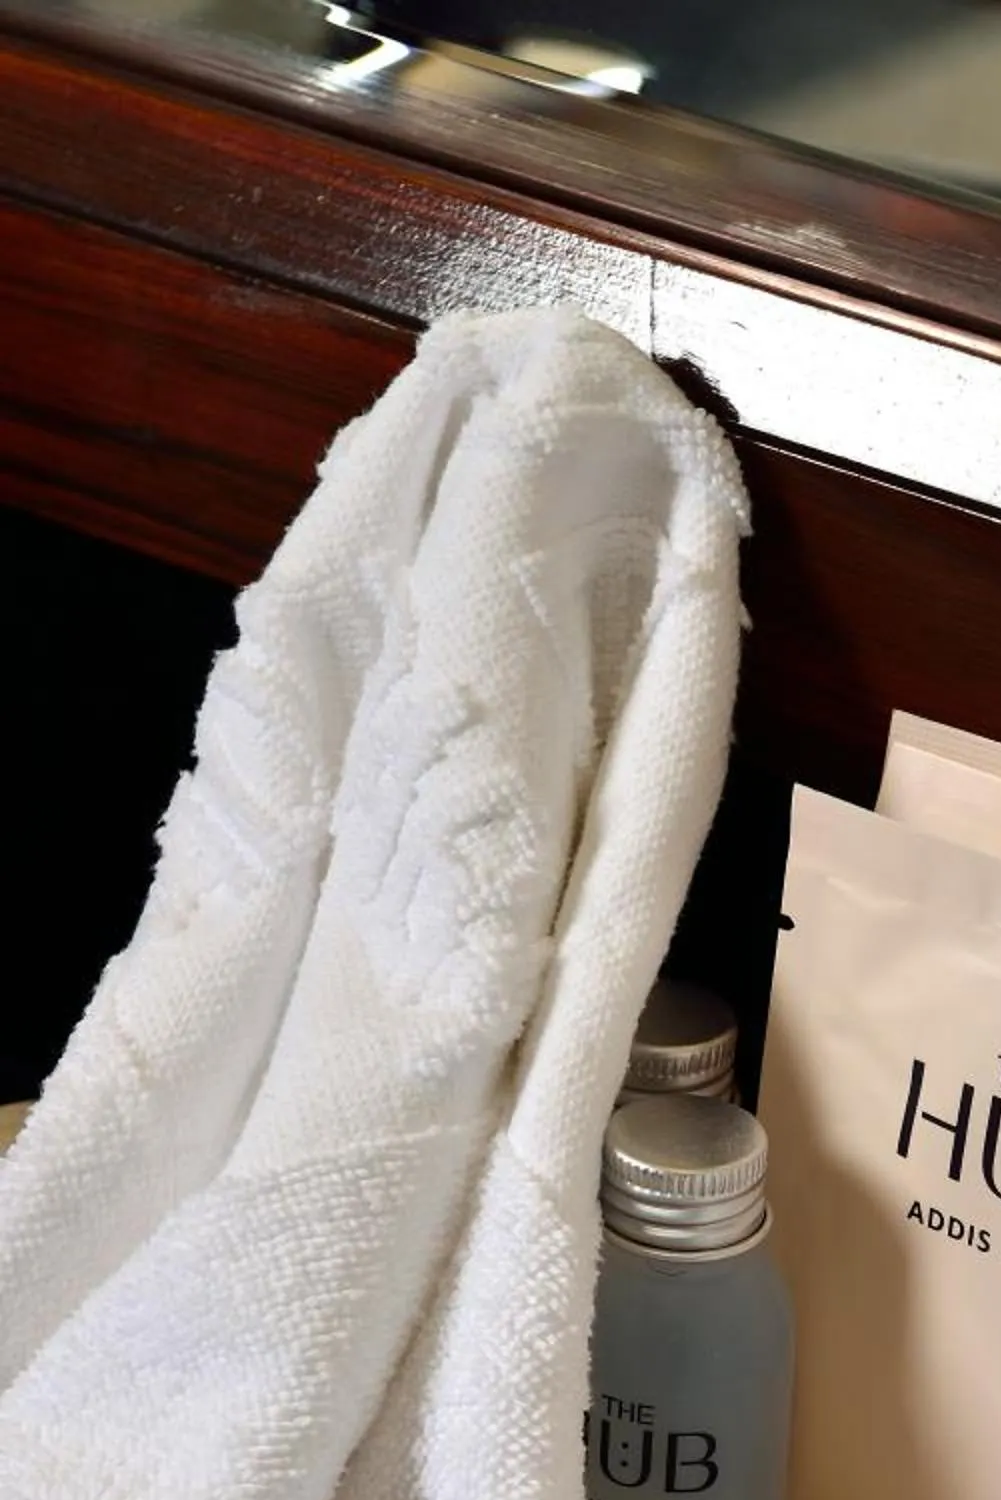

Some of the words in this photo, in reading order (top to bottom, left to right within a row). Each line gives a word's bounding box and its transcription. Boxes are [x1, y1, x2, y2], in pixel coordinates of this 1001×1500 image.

[906, 1200, 992, 1253] ADDIS
[601, 1393, 656, 1426] THE
[583, 1411, 719, 1493] UB
